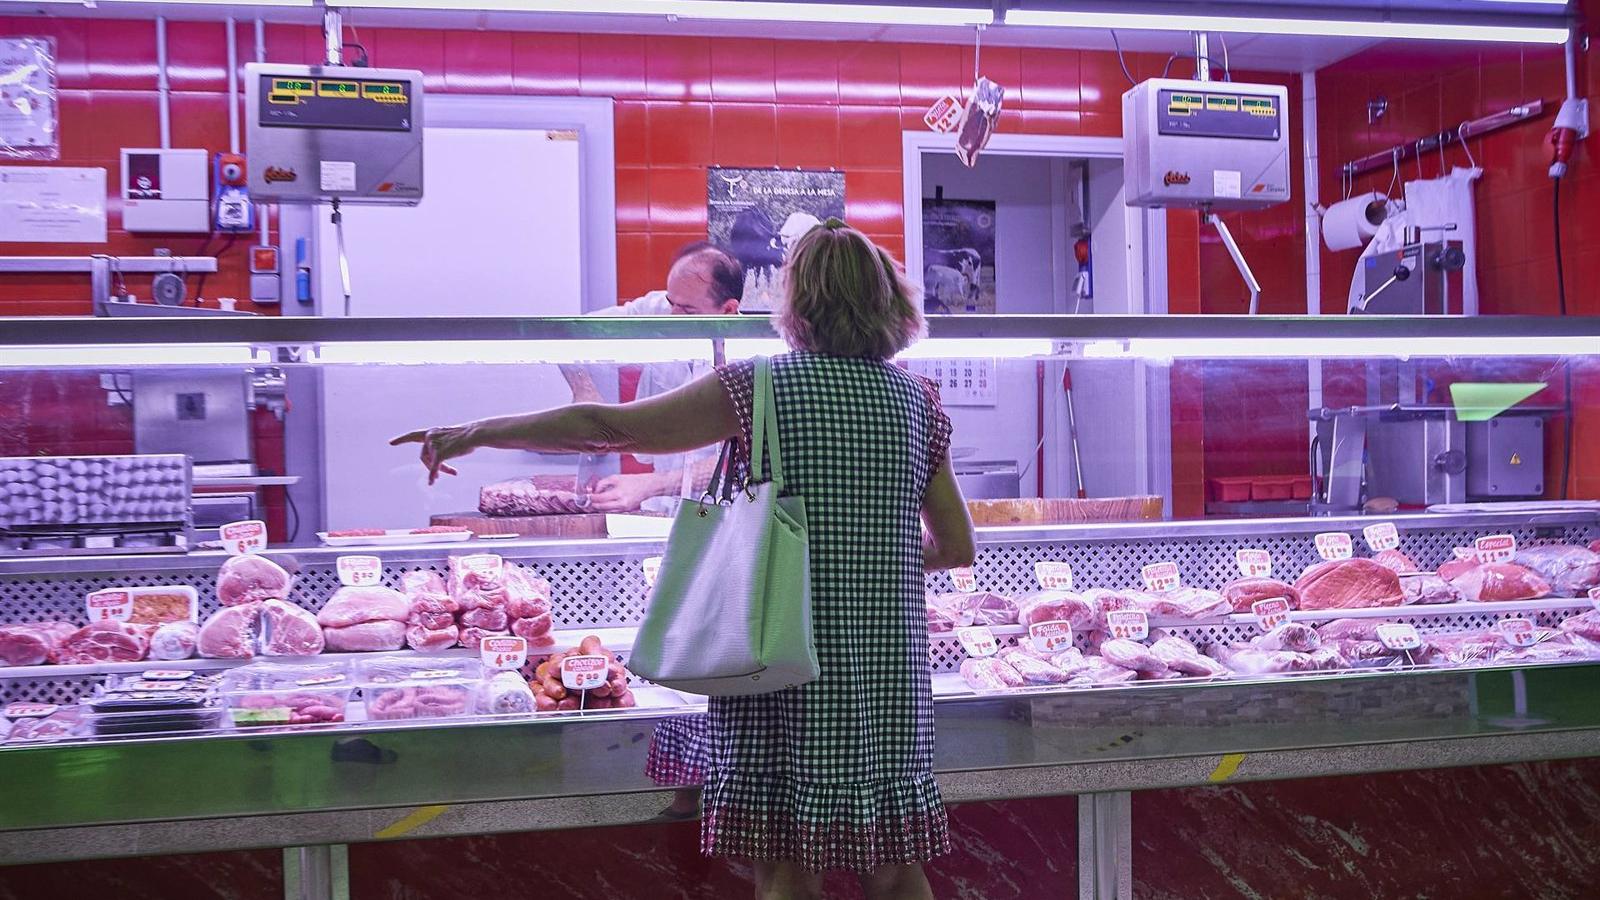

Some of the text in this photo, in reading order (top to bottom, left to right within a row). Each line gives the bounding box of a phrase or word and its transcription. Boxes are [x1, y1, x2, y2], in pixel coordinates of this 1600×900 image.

[964, 368, 972, 377] 20
[949, 379, 957, 388] 26
[964, 380, 972, 388] 27
